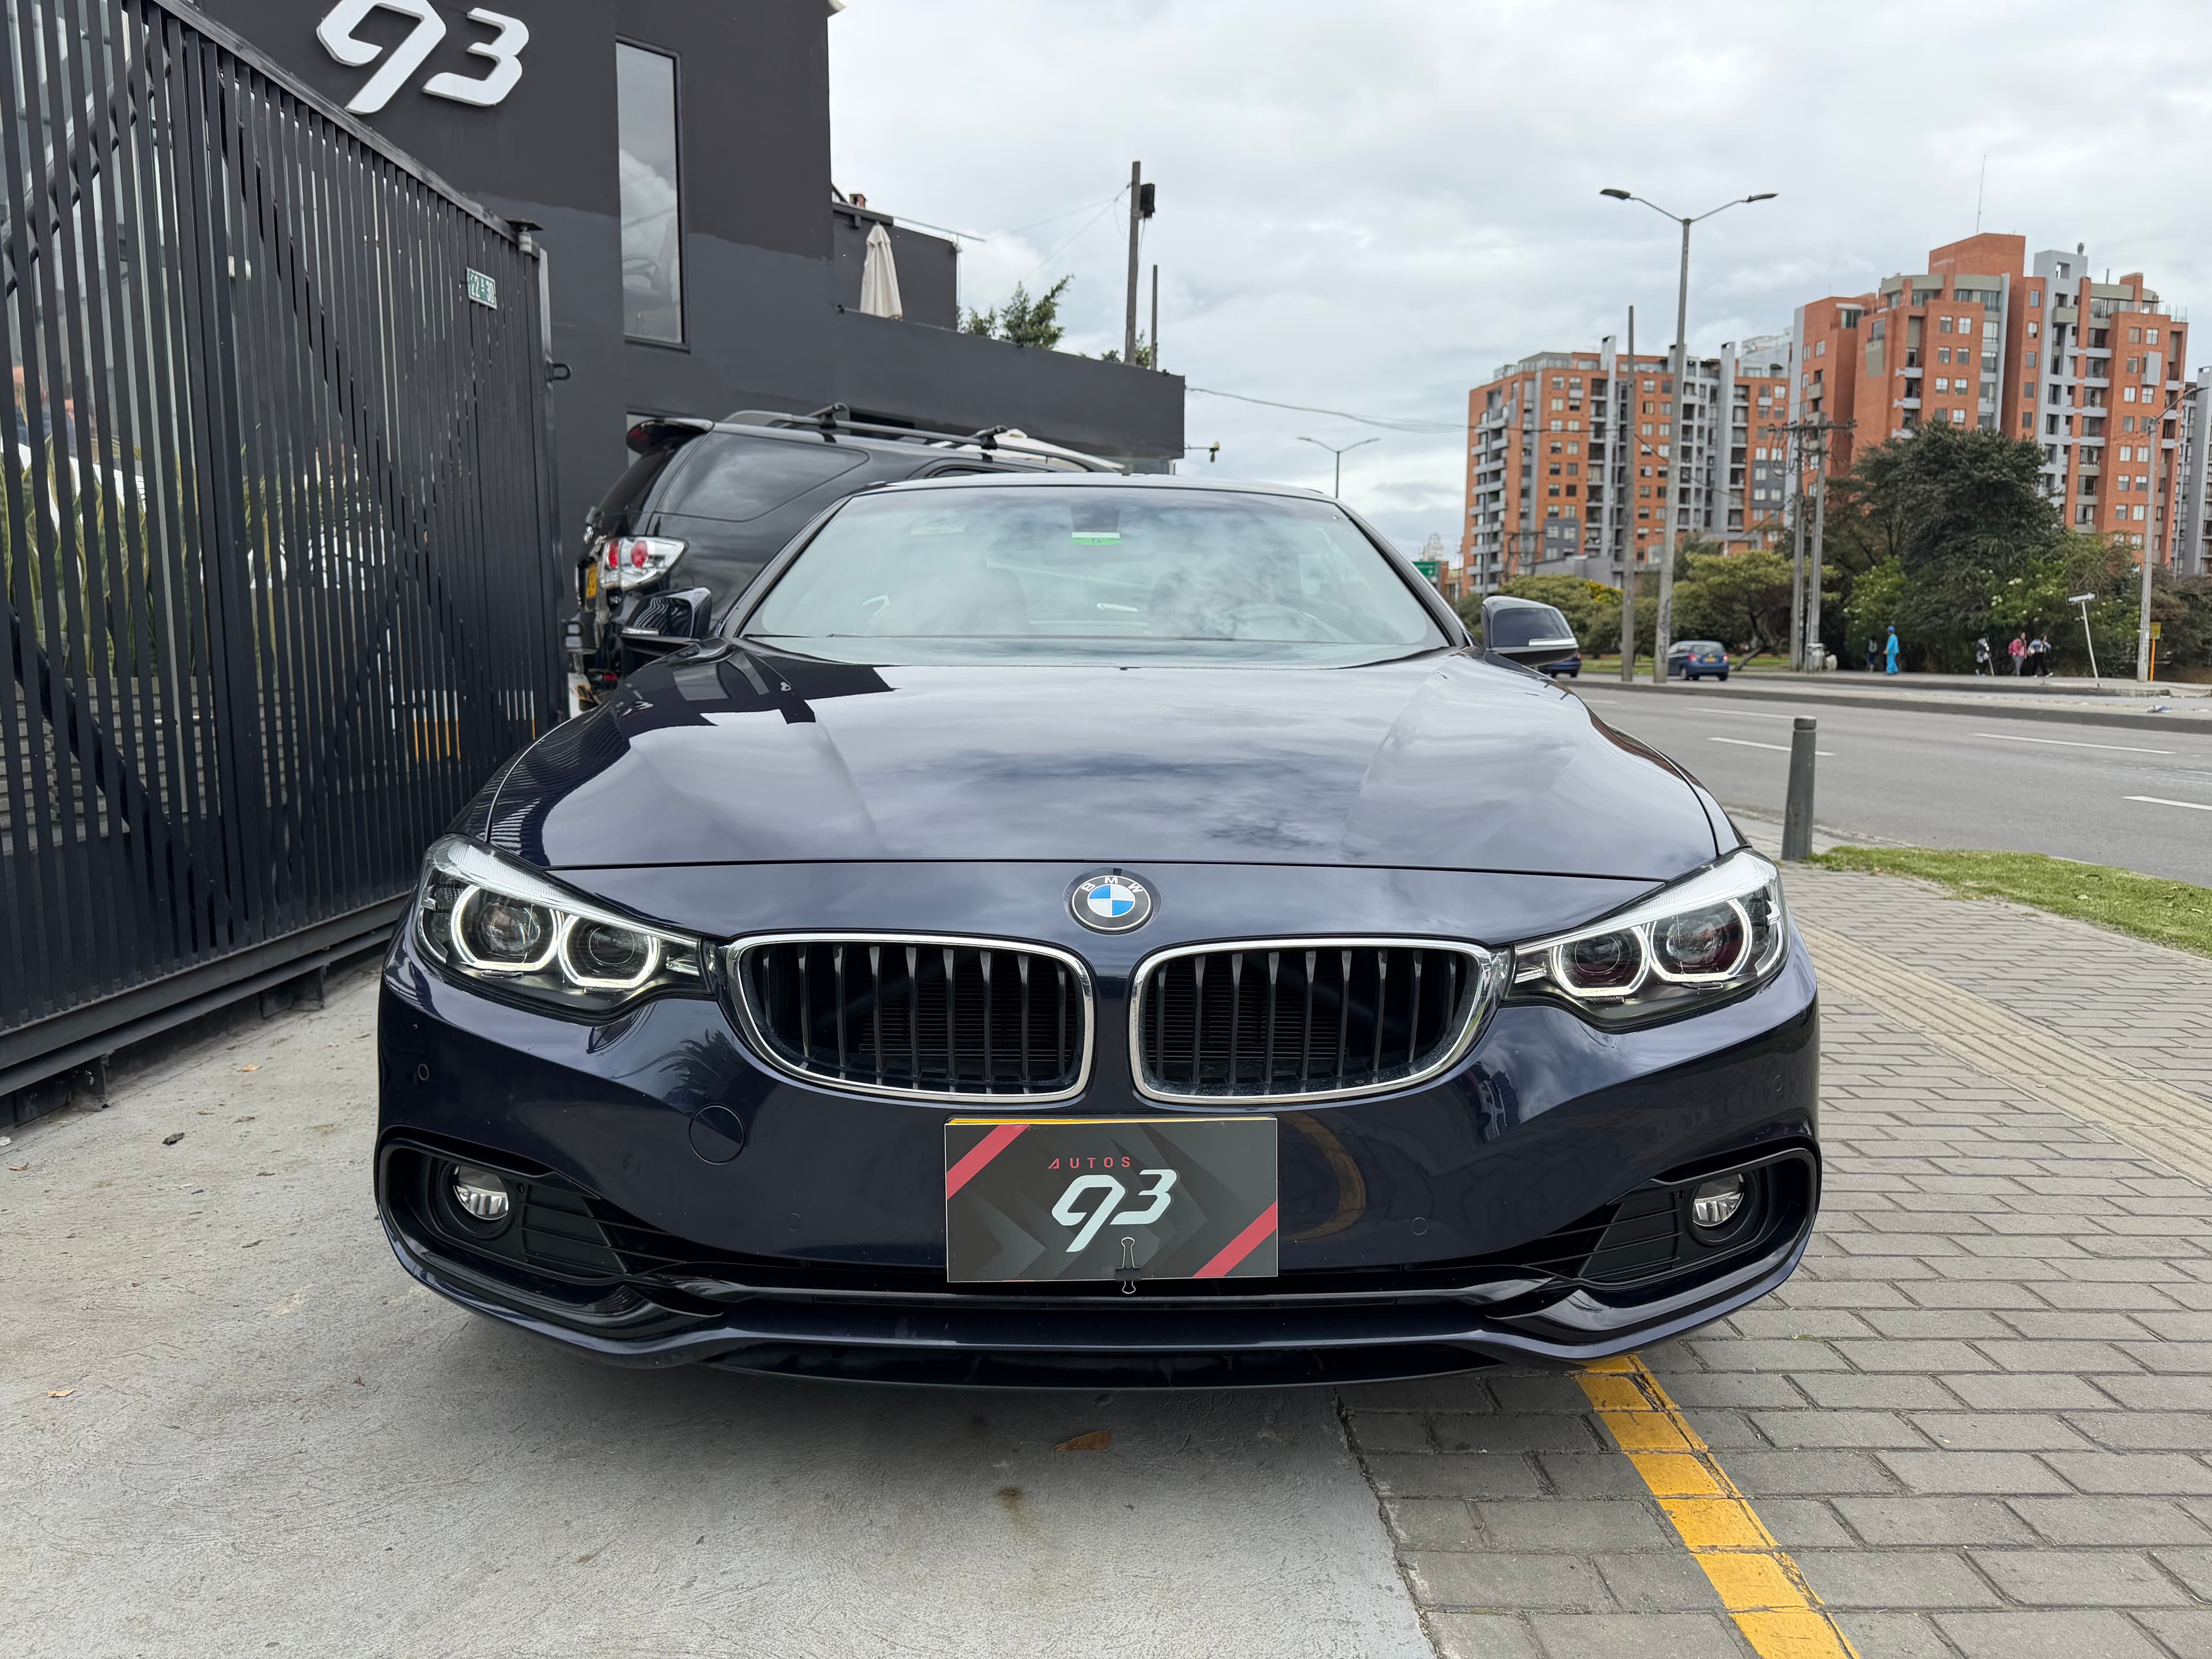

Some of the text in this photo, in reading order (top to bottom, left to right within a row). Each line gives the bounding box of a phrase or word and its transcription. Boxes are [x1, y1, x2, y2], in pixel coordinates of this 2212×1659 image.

[316, 0, 529, 115] 93
[1081, 876, 1143, 893] BMW
[1048, 1156, 1131, 1169] AUTOS
[1052, 1169, 1177, 1252] 93
